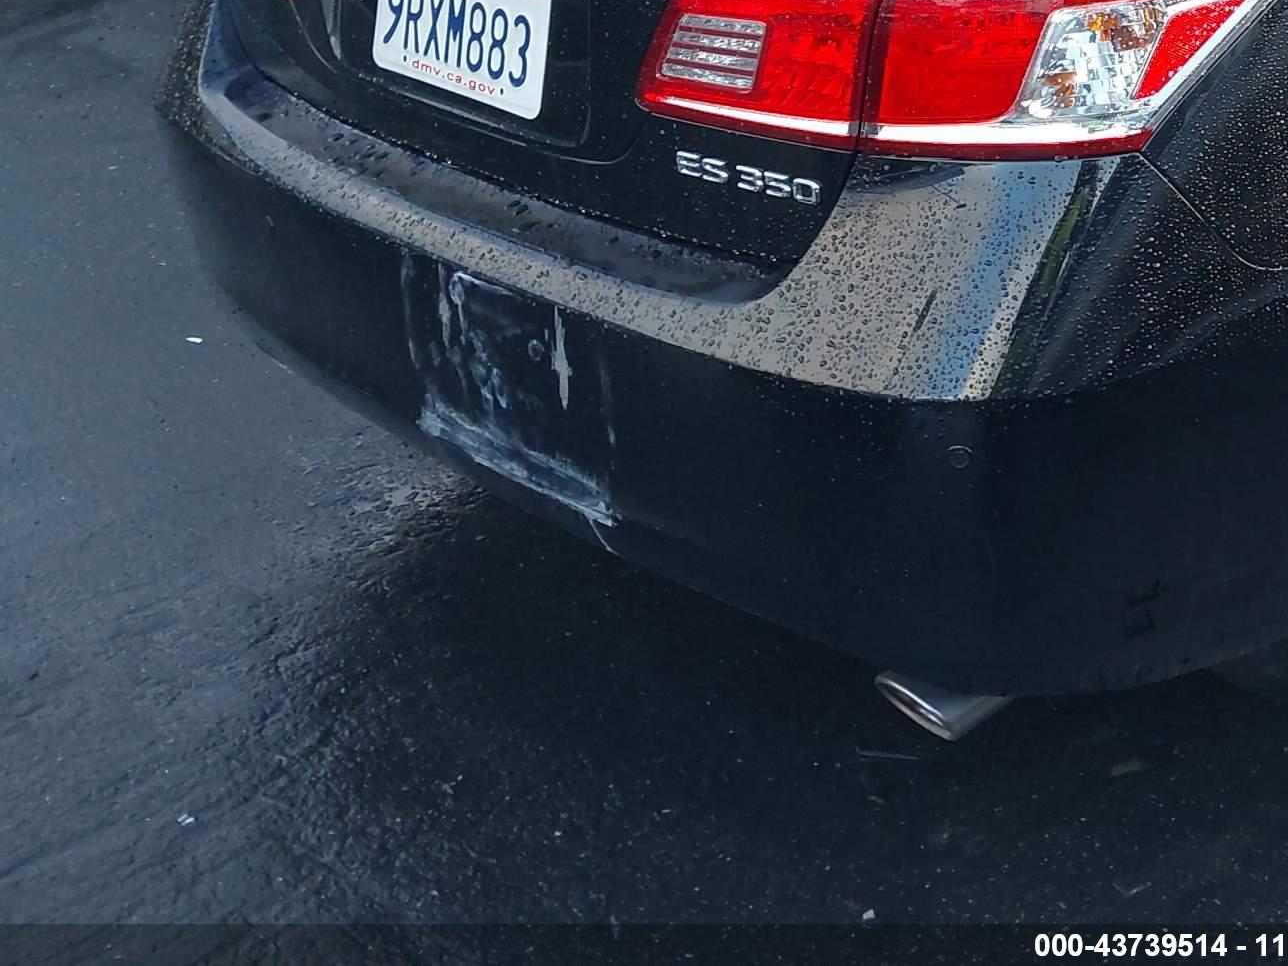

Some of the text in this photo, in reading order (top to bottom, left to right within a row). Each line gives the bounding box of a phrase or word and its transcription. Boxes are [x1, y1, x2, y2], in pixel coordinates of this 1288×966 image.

[412, 59, 496, 94] dmv.ca.gov
[676, 150, 822, 206] ES 350
